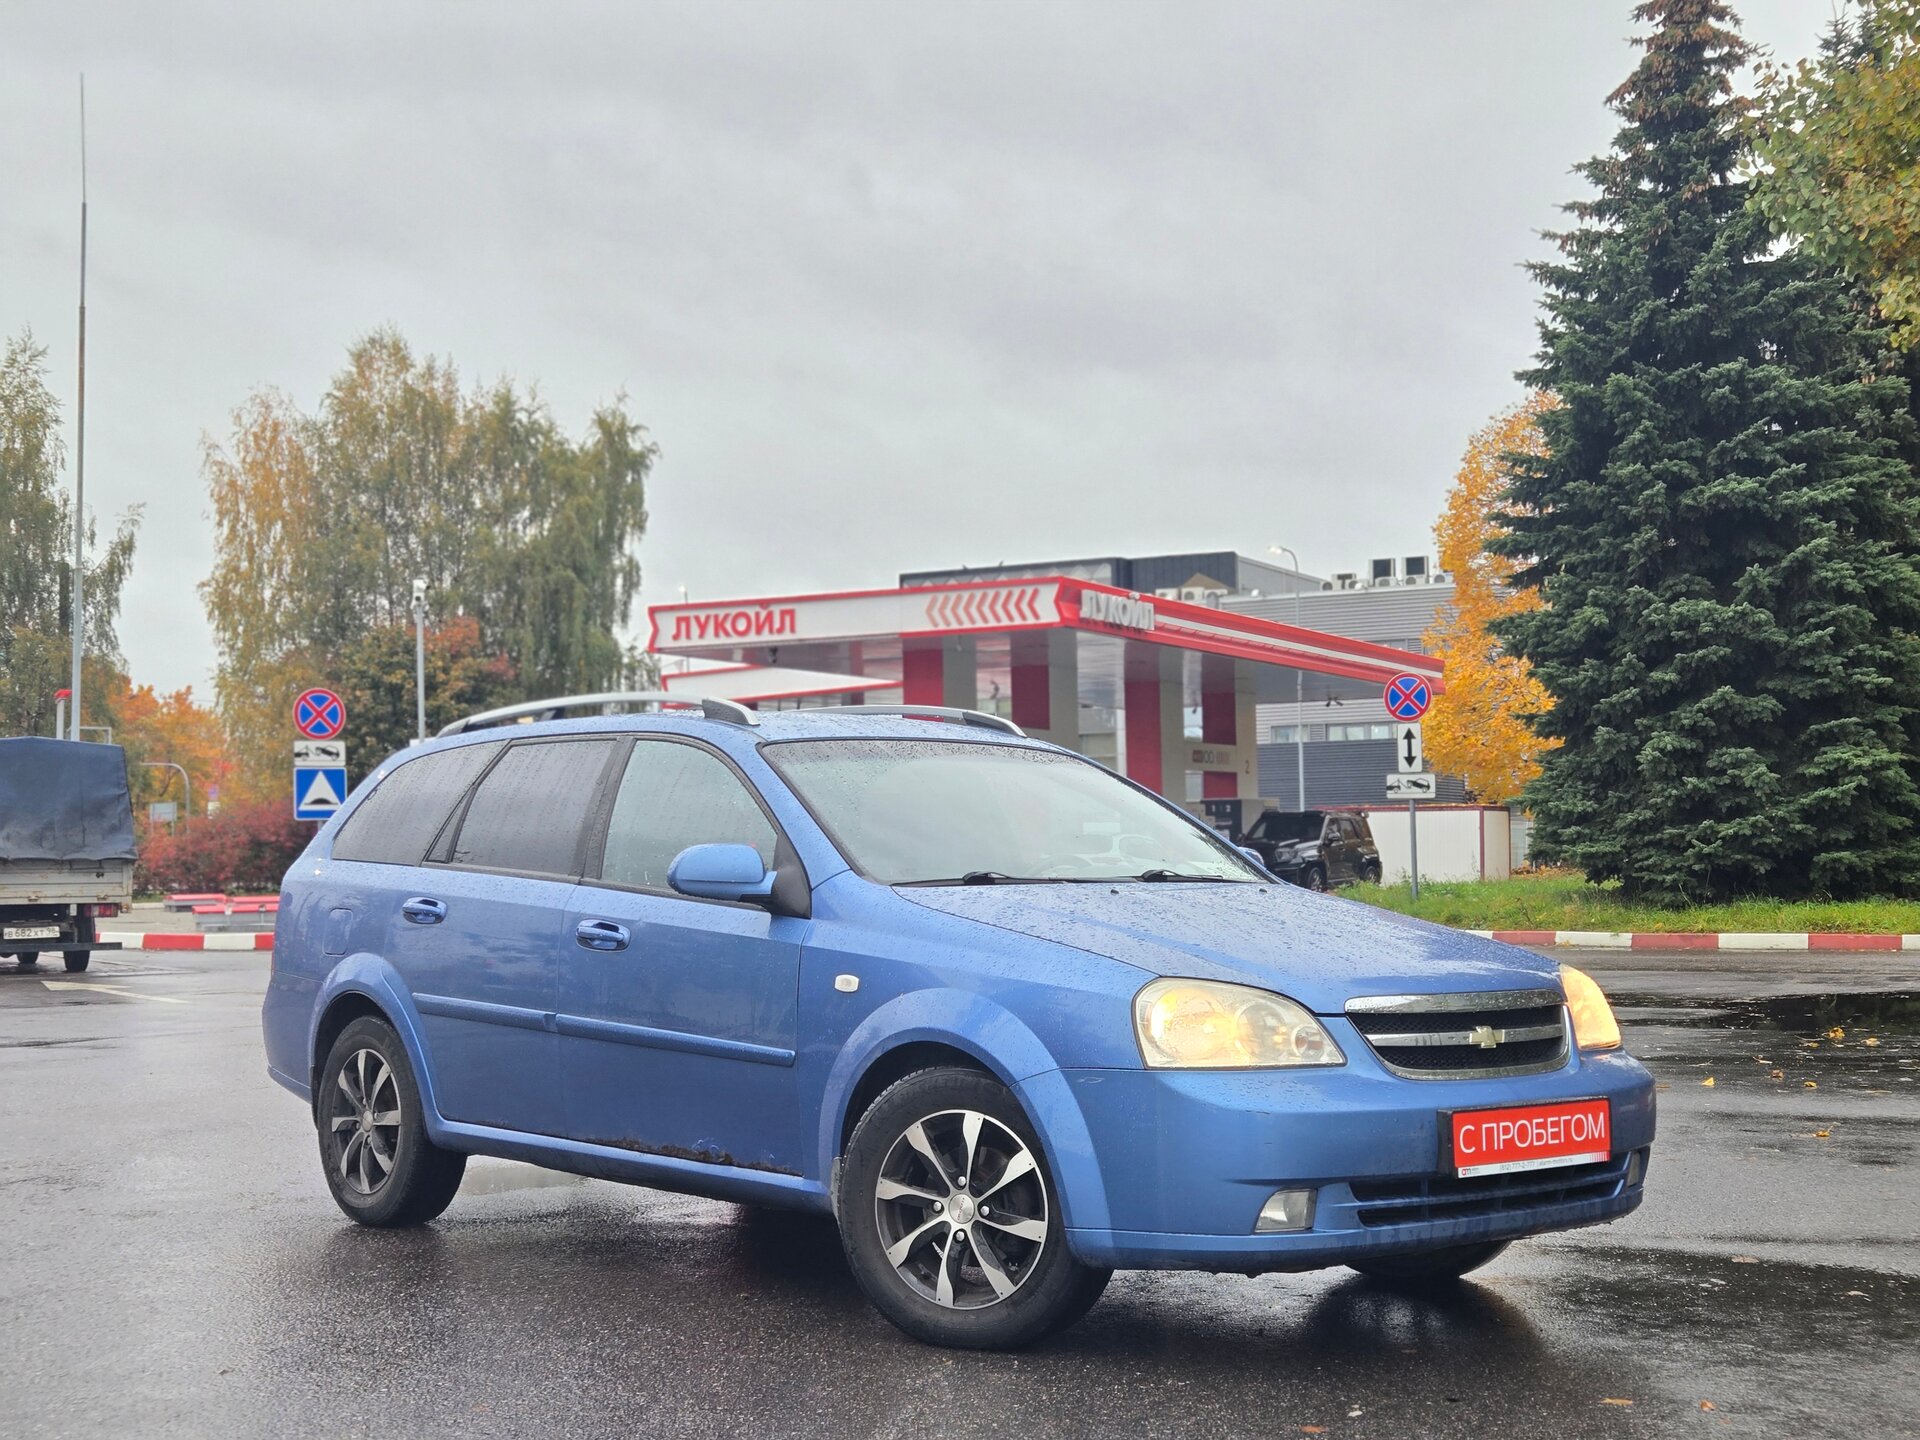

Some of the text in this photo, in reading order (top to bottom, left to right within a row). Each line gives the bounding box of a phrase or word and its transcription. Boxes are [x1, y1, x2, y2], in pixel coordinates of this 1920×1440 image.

[672, 602, 796, 641] ЛУКОЙЛ
[1080, 588, 1155, 631] ЛУКОЙЛ
[1459, 1112, 1605, 1154] С ПРОБЕГОМ
